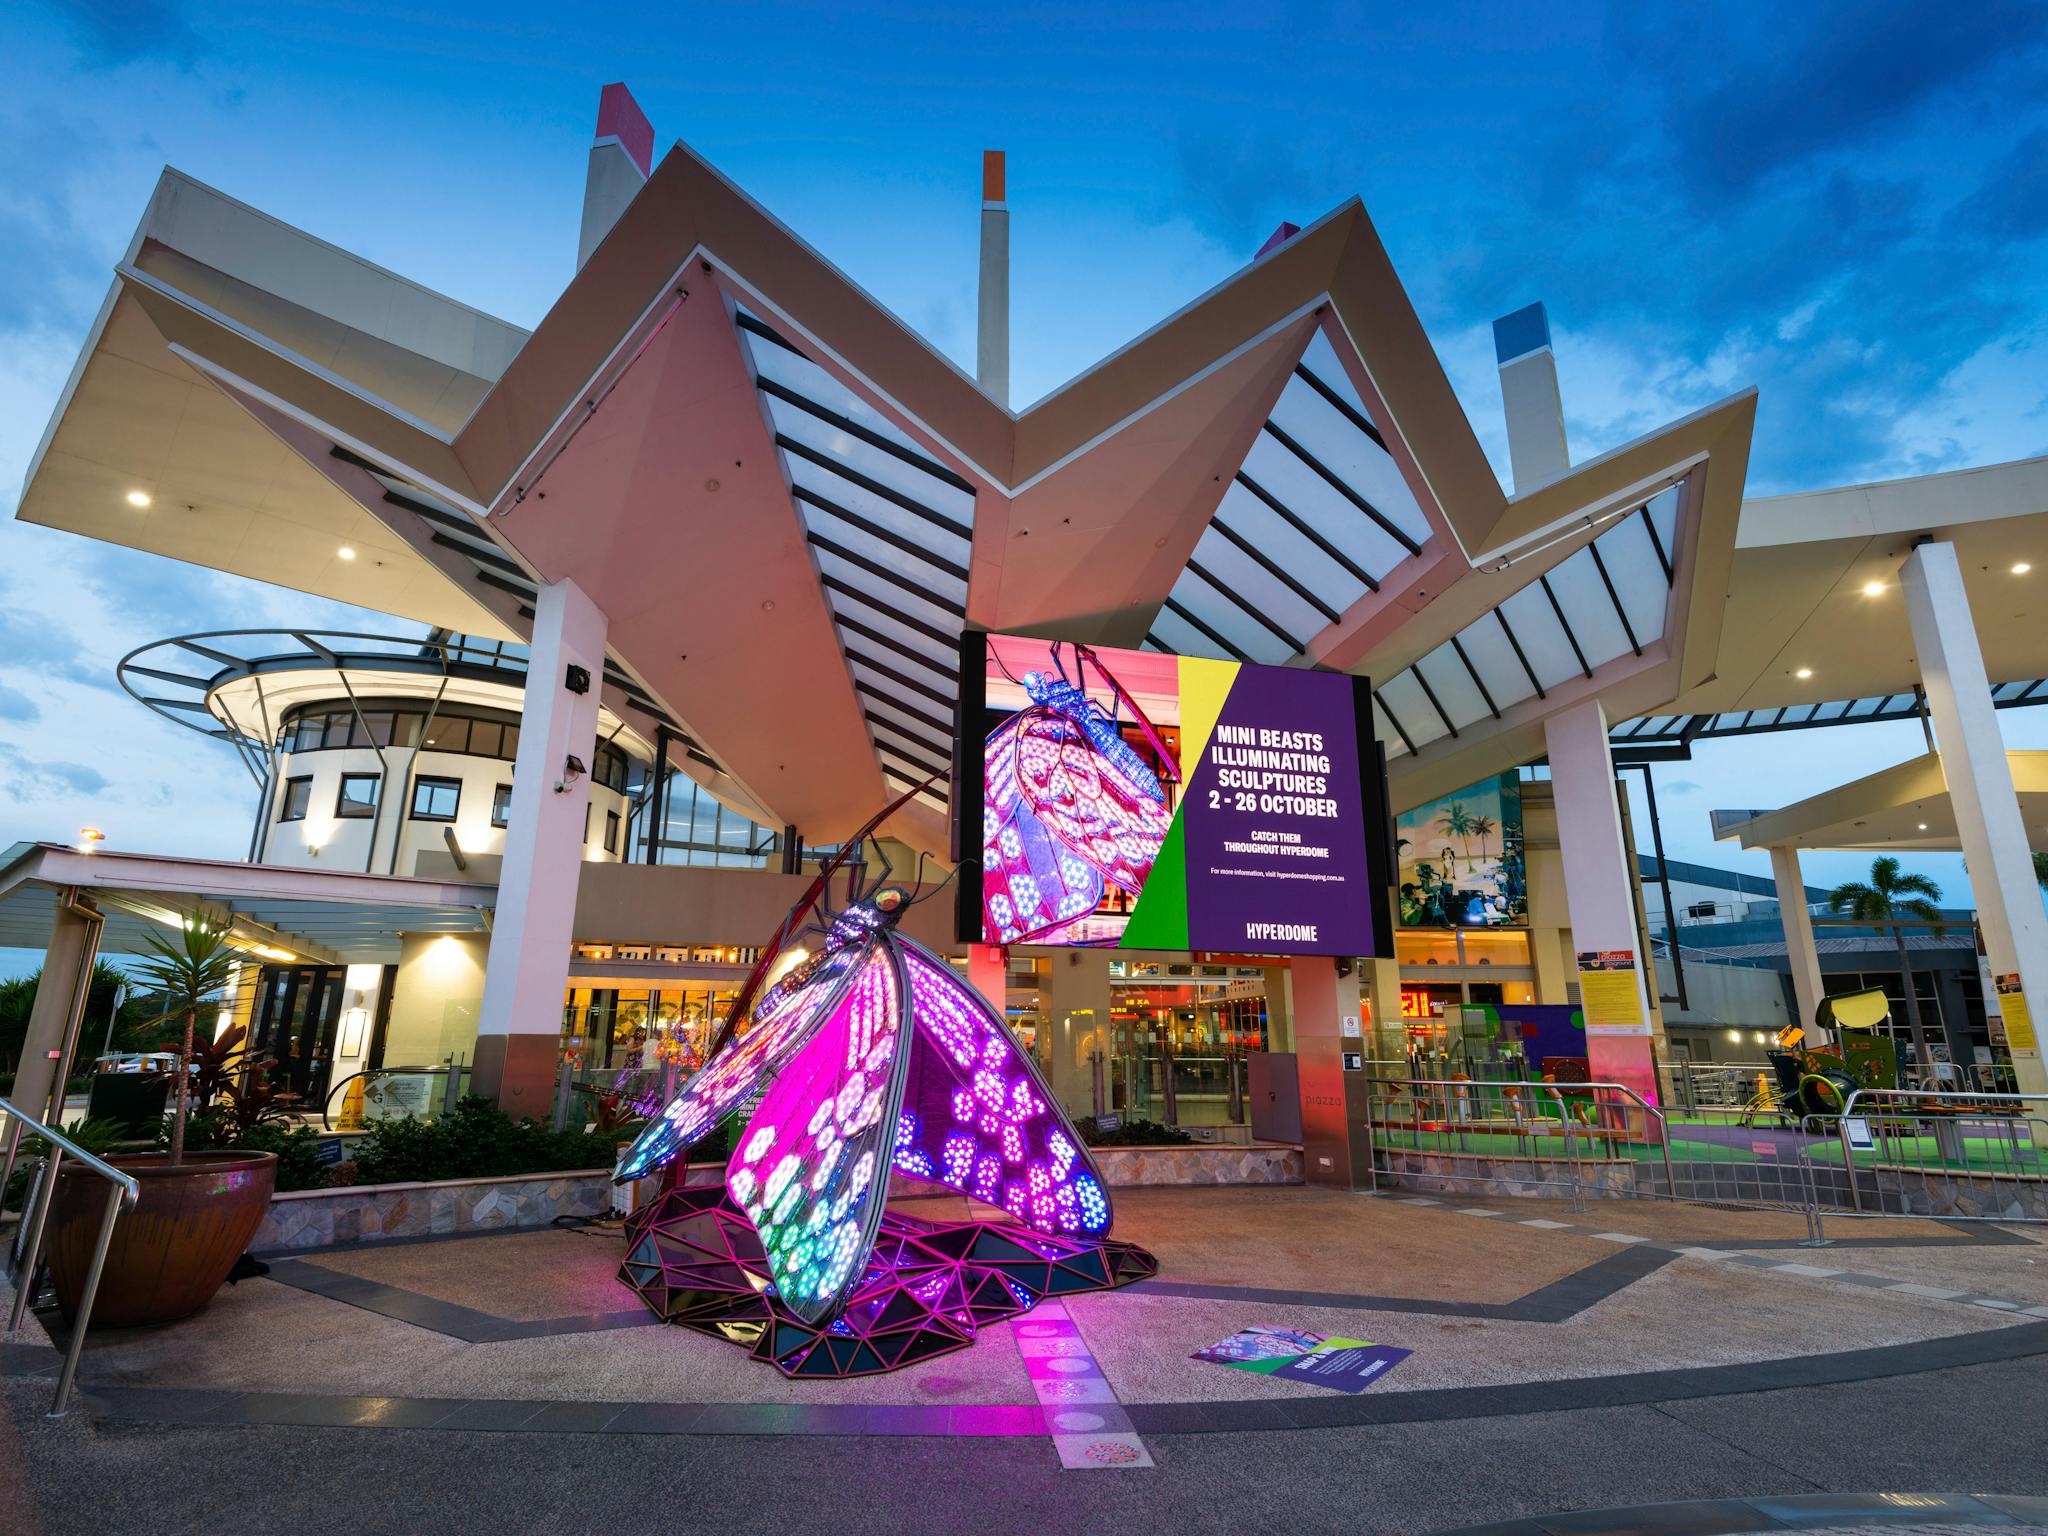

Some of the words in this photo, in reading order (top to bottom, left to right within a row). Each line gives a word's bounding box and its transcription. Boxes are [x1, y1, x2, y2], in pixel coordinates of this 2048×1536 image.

[1217, 725, 1255, 746] MINI
[1260, 728, 1323, 751] BEASTS
[1211, 746, 1331, 774] ILLUMINATING
[1218, 769, 1327, 795] SCULPTURES
[1208, 790, 1220, 809] 2
[1235, 792, 1257, 812] 26
[1260, 794, 1338, 818] OCTOBER
[1251, 830, 1278, 842] CATCH
[1279, 832, 1301, 844] THEM
[1223, 841, 1279, 855] THROUGHOUT
[1280, 845, 1329, 858] HYPERDOME
[1210, 867, 1220, 875] For
[1220, 868, 1234, 876] more
[1246, 922, 1317, 942] HYPERDOME
[1305, 1096, 1342, 1106] piazza
